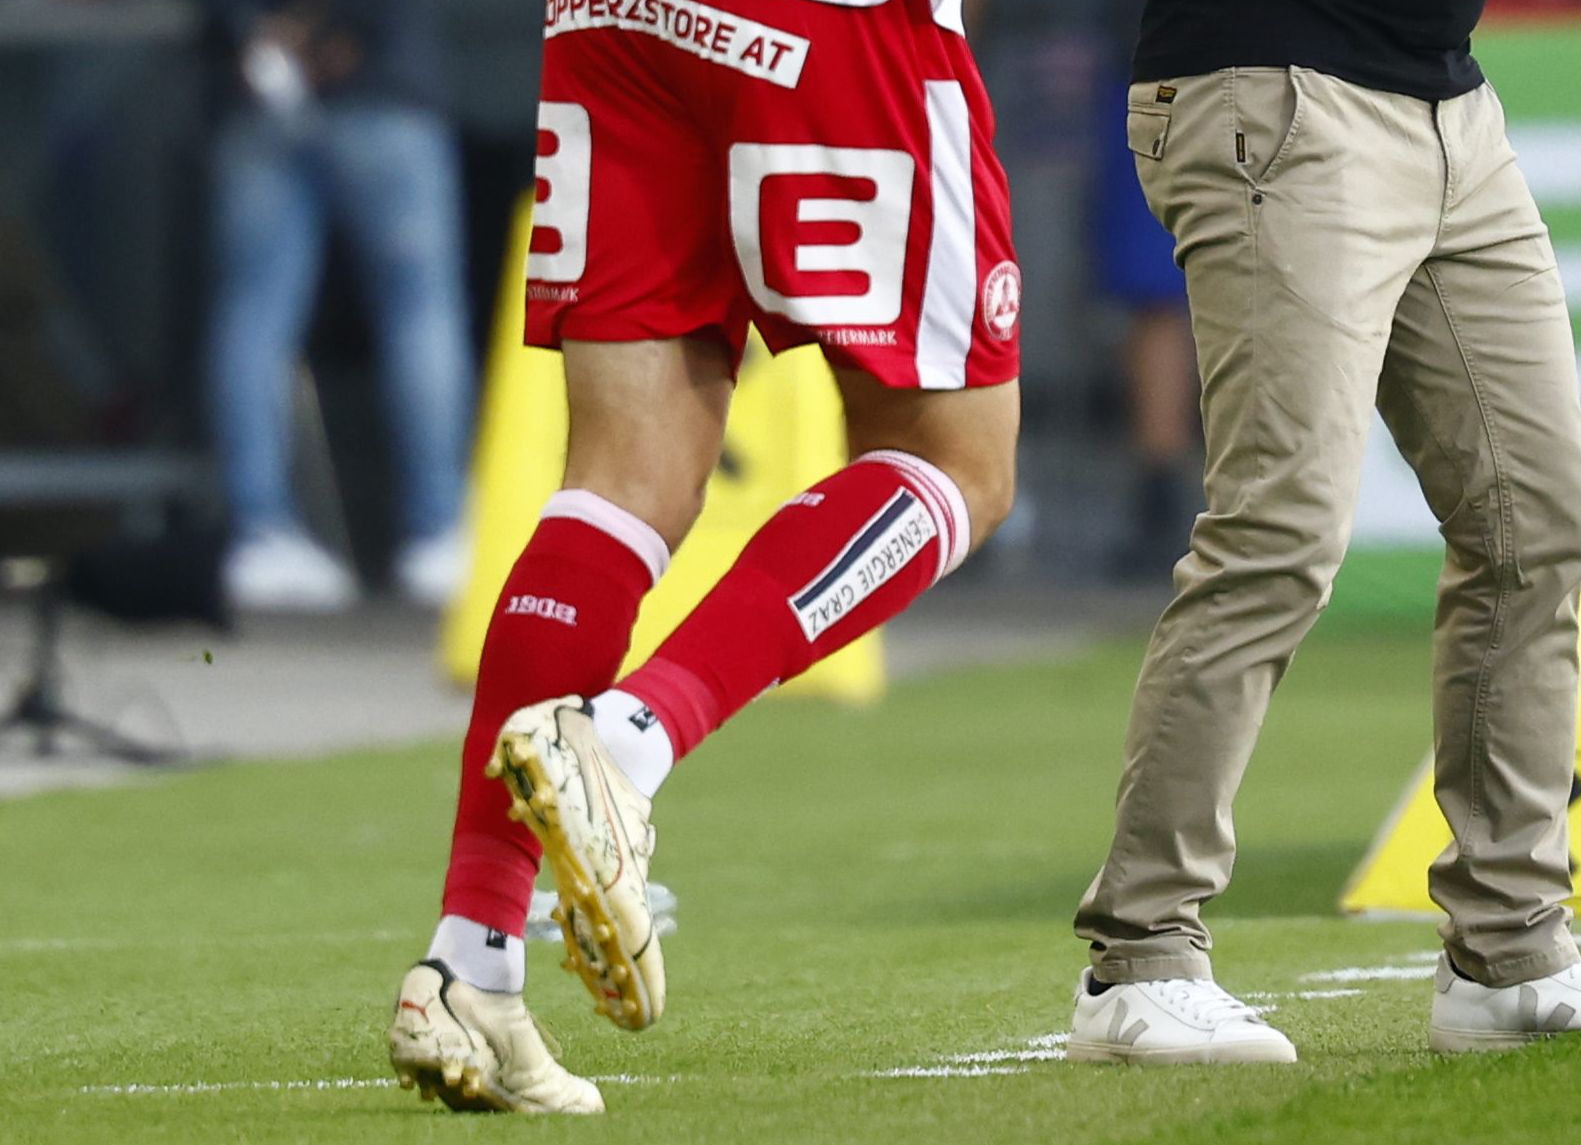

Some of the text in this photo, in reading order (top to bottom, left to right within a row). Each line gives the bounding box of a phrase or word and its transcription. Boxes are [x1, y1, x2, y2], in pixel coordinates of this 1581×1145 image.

[740, 35, 794, 71] AT
[807, 517, 923, 635] ENERGIE GRAZ
